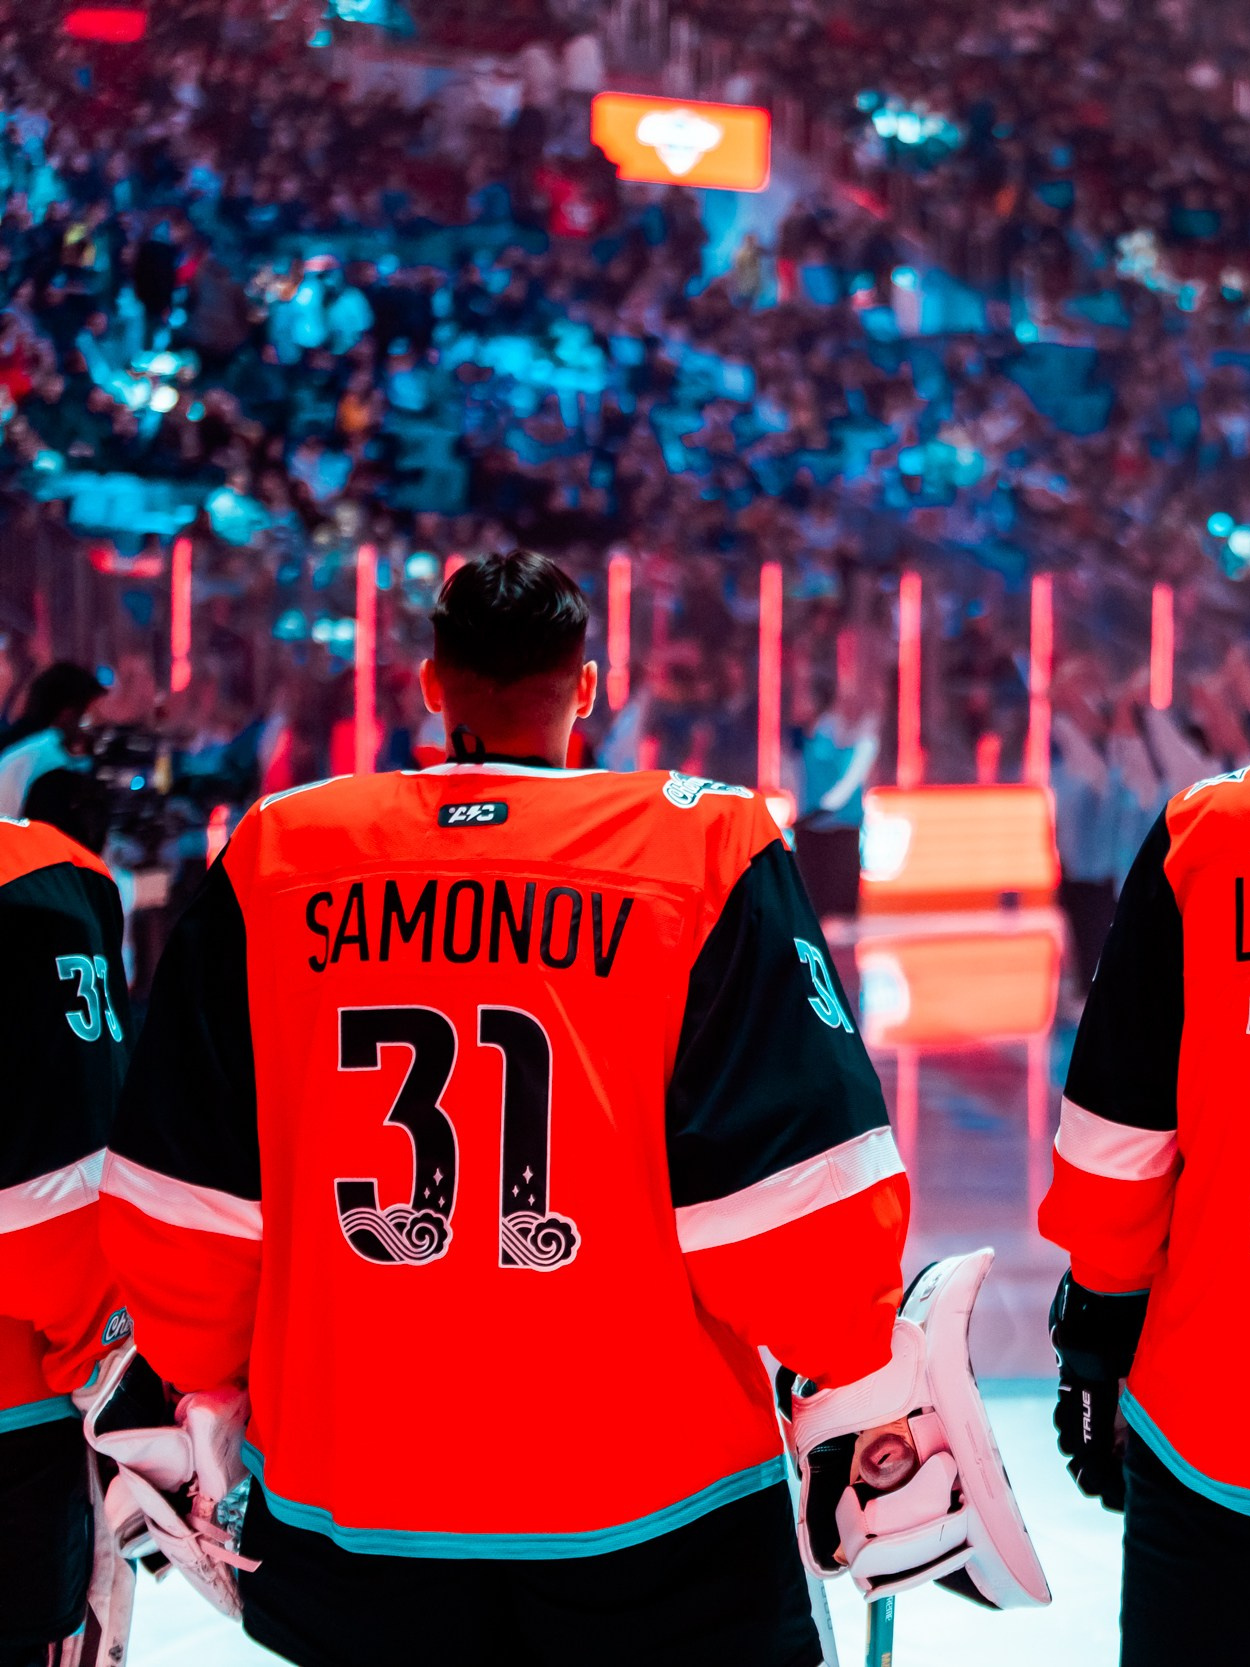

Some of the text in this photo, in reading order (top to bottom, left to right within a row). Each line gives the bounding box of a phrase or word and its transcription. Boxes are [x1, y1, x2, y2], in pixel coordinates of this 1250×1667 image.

[305, 879, 634, 978] SAMONOV
[334, 1004, 581, 1271] 31
[1081, 1389, 1093, 1444] TRUE
